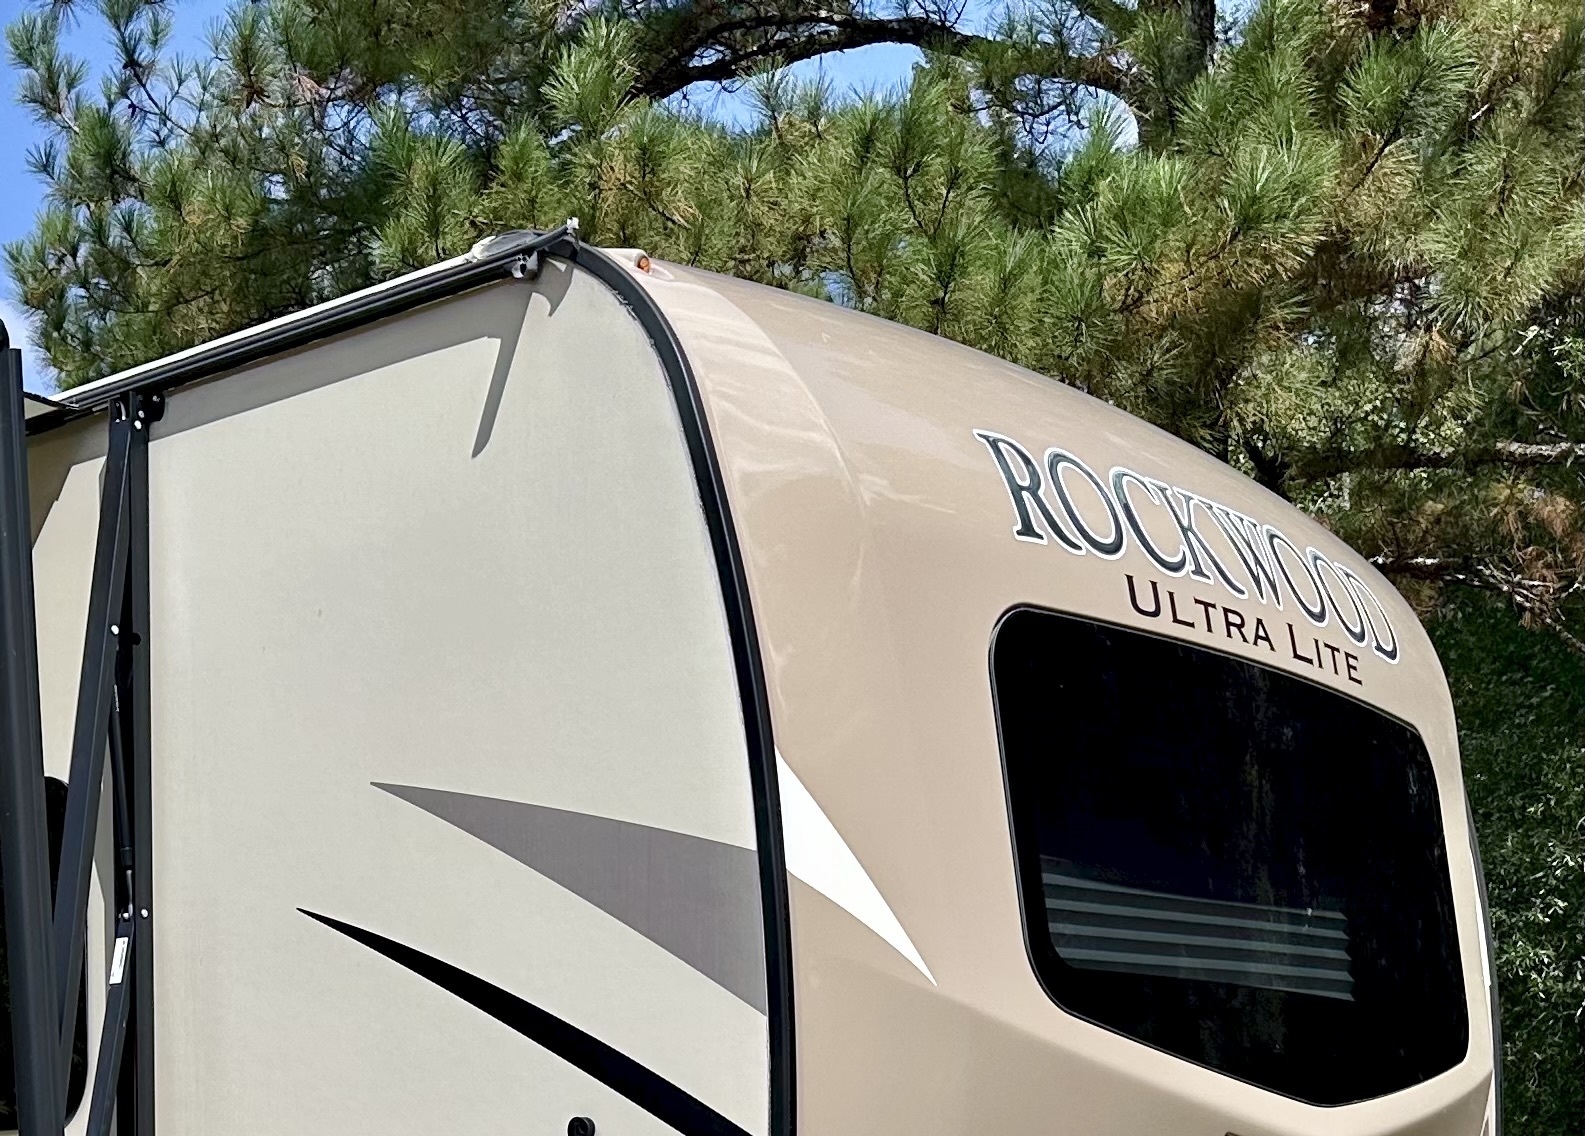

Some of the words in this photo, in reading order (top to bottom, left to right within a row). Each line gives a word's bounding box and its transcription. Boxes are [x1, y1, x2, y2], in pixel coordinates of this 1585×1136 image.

[973, 429, 1400, 664] ROCKWOOD
[1123, 573, 1276, 652] ULTRA
[1287, 622, 1364, 687] LITE
